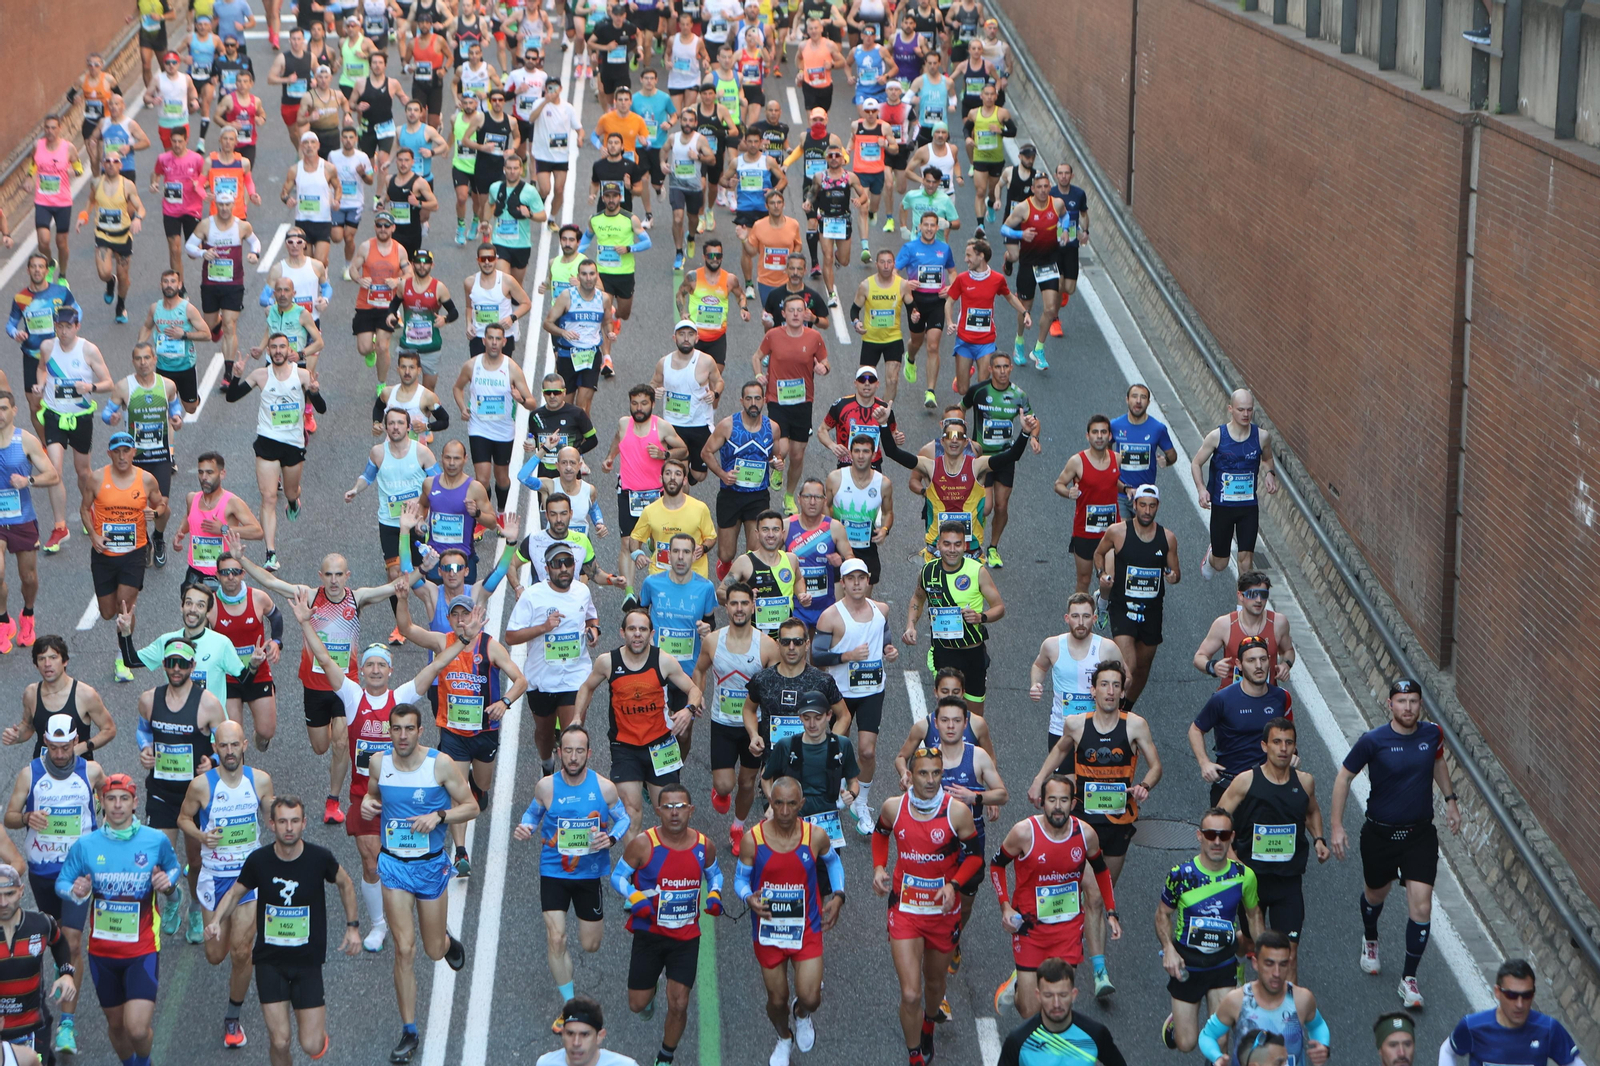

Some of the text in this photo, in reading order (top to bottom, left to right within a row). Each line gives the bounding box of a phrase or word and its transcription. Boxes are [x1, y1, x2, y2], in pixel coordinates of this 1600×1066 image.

[475, 377, 506, 387] PORTUGAL
[398, 492, 416, 500] ZURICH
[445, 671, 488, 684] ATLETISMO
[451, 680, 482, 693] CAMAS
[53, 807, 78, 815] ZURICH
[229, 816, 253, 826] ZURICH
[572, 820, 595, 828] ZURICH
[228, 837, 249, 846] CLAUDIO
[400, 834, 415, 842] 3814
[95, 871, 151, 882] INFORMALES
[662, 878, 700, 888] Pequiven
[764, 881, 805, 890] Pequiven
[916, 880, 939, 888] ZURICH
[1052, 885, 1073, 895] ZURICH
[775, 891, 799, 899] ZURICH
[108, 904, 134, 912] ZURICH
[771, 902, 792, 912] GUIA
[279, 909, 304, 917] ZURICH
[1206, 919, 1229, 929] ZURICH
